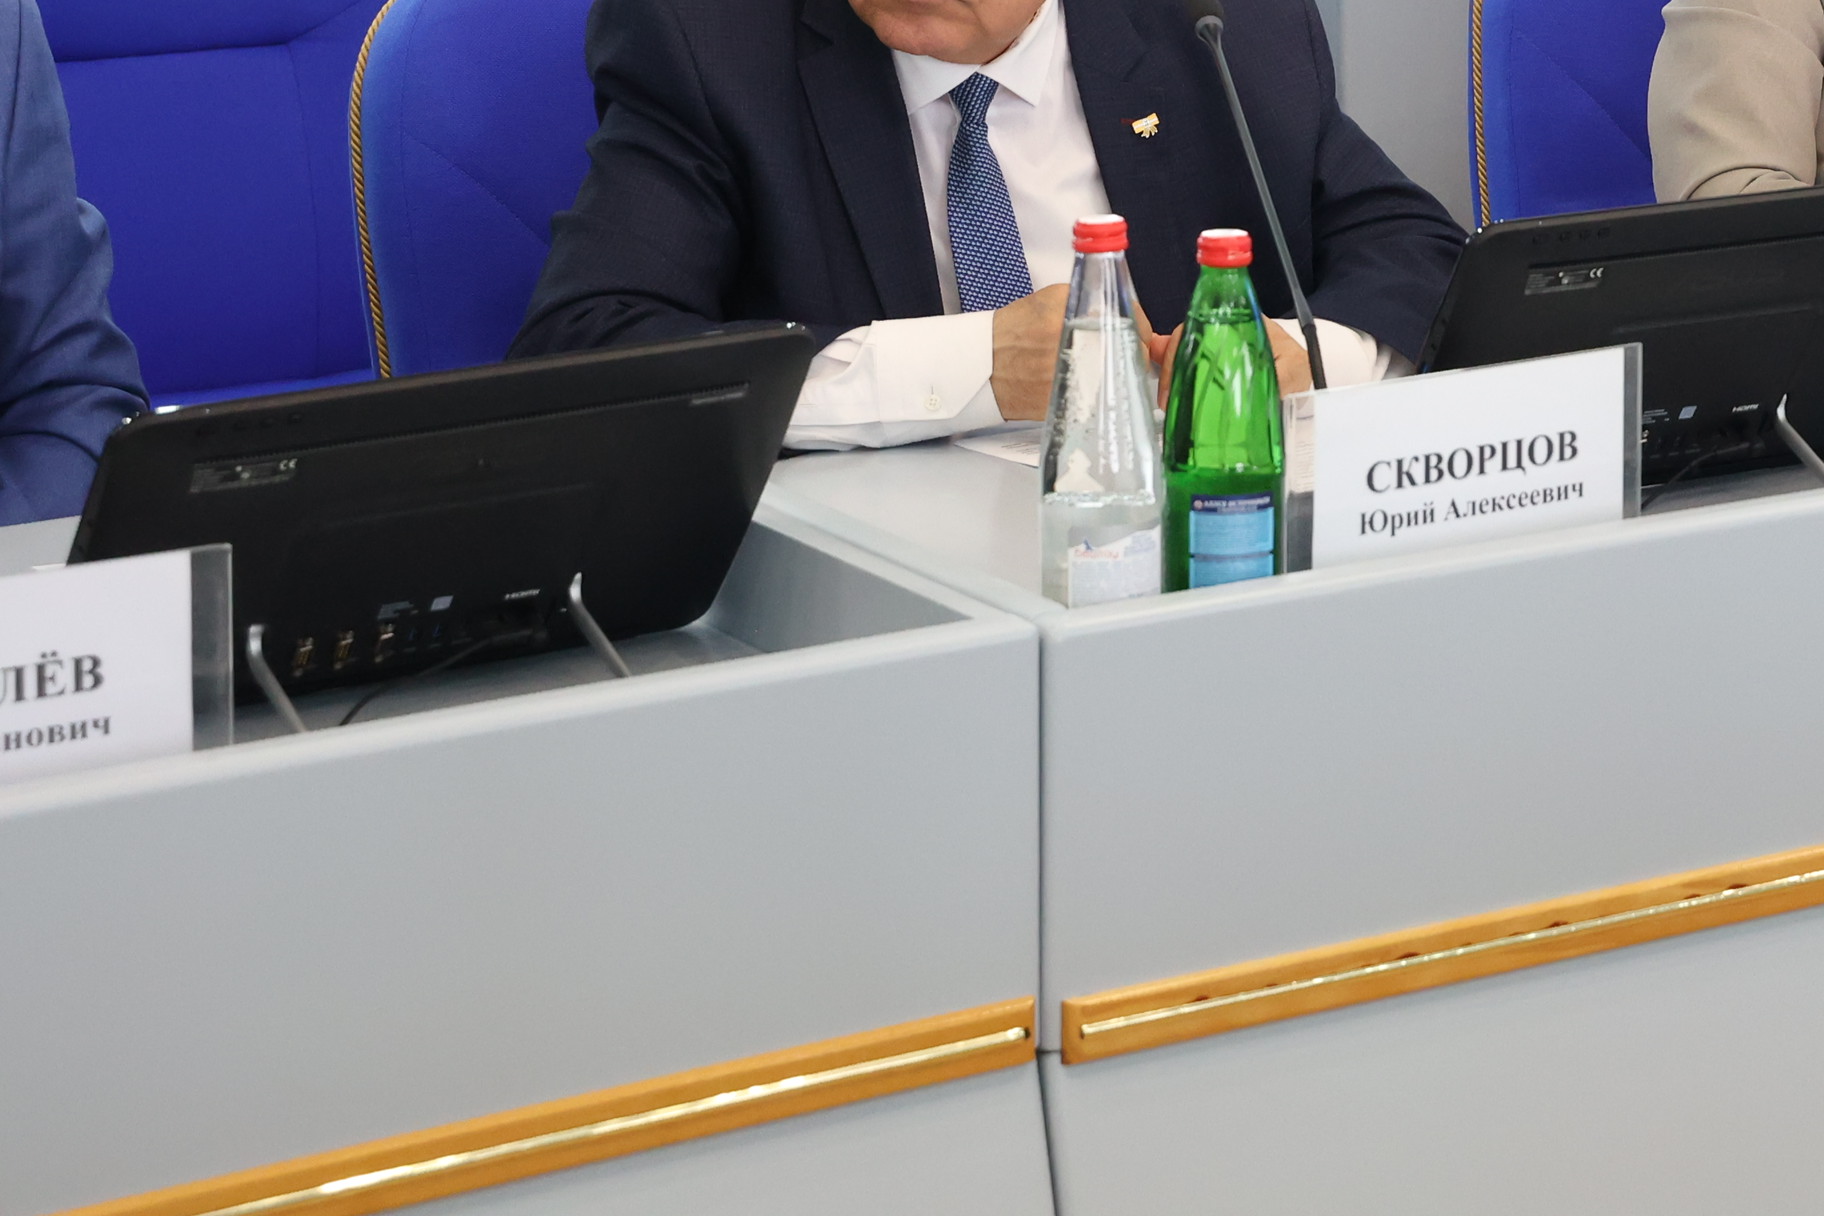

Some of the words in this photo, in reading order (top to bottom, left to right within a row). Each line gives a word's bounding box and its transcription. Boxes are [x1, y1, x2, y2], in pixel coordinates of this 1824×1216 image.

[1366, 430, 1578, 493] СКВОРЦОВ
[1359, 501, 1436, 537] Юрий
[1444, 482, 1584, 522] Алексеевич
[4, 716, 111, 752] нович
